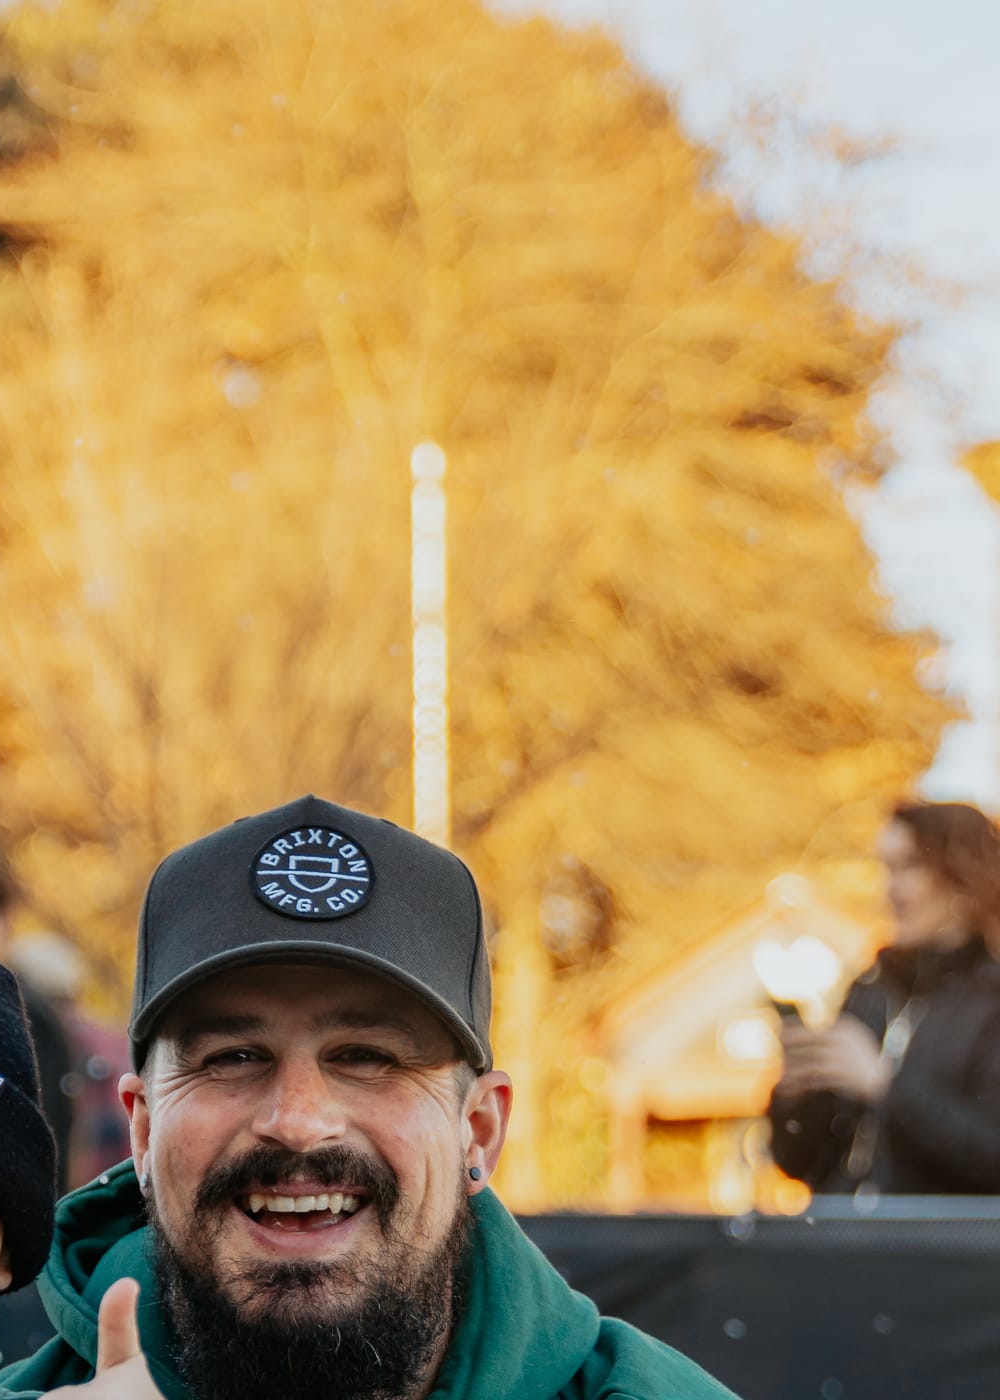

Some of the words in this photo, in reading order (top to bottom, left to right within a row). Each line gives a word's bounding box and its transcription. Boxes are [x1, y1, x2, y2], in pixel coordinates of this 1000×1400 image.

[260, 828, 368, 873] BRIXTON
[260, 881, 320, 912] MFG.
[326, 888, 364, 911] CO.
